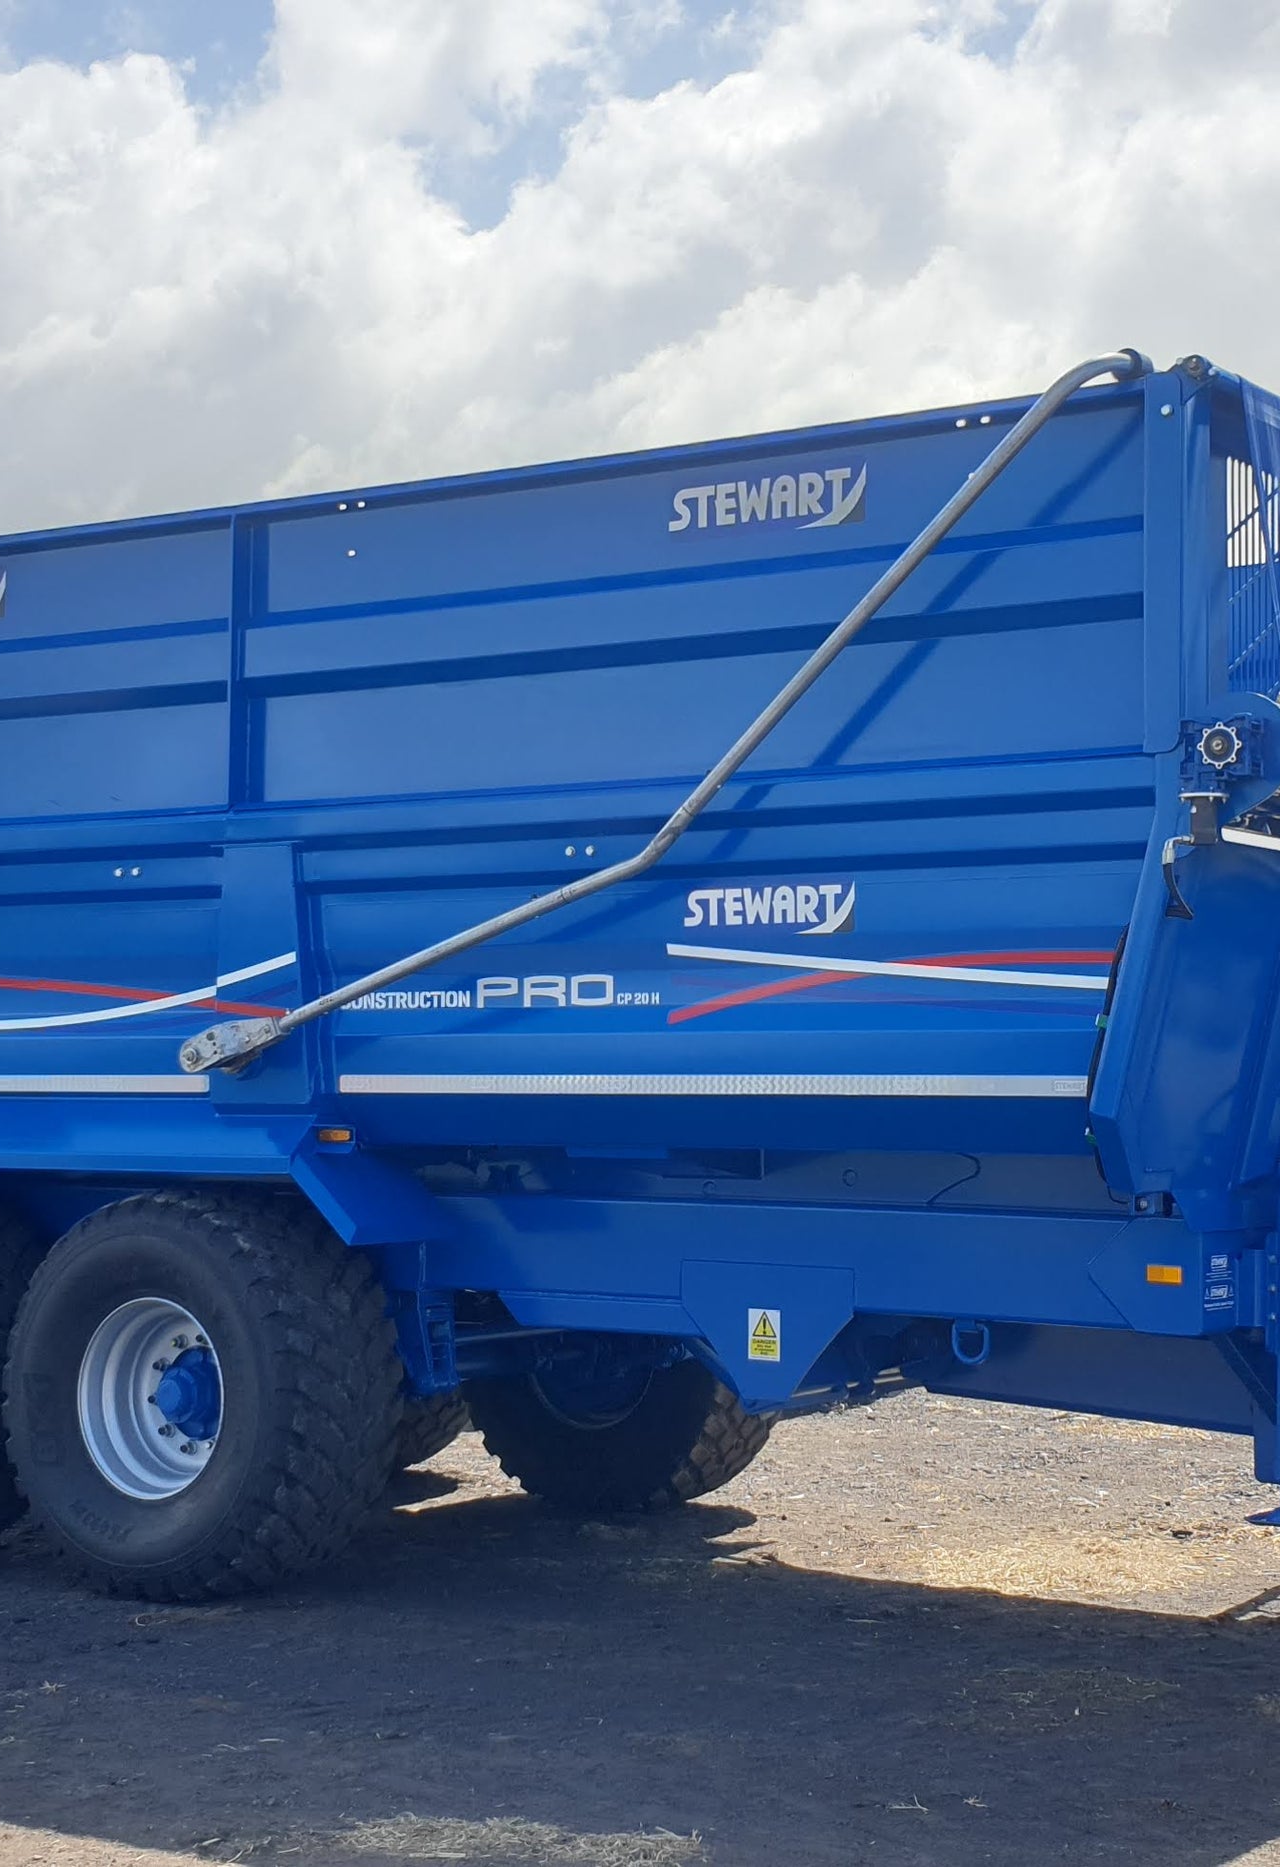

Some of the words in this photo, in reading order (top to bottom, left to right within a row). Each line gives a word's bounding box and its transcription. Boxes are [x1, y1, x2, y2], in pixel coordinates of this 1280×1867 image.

[669, 462, 867, 532] STEWART
[684, 880, 856, 935] STEWART
[476, 974, 614, 1008] PRO
[616, 992, 633, 1005] CP
[633, 992, 650, 1005] 20
[651, 992, 660, 1005] H
